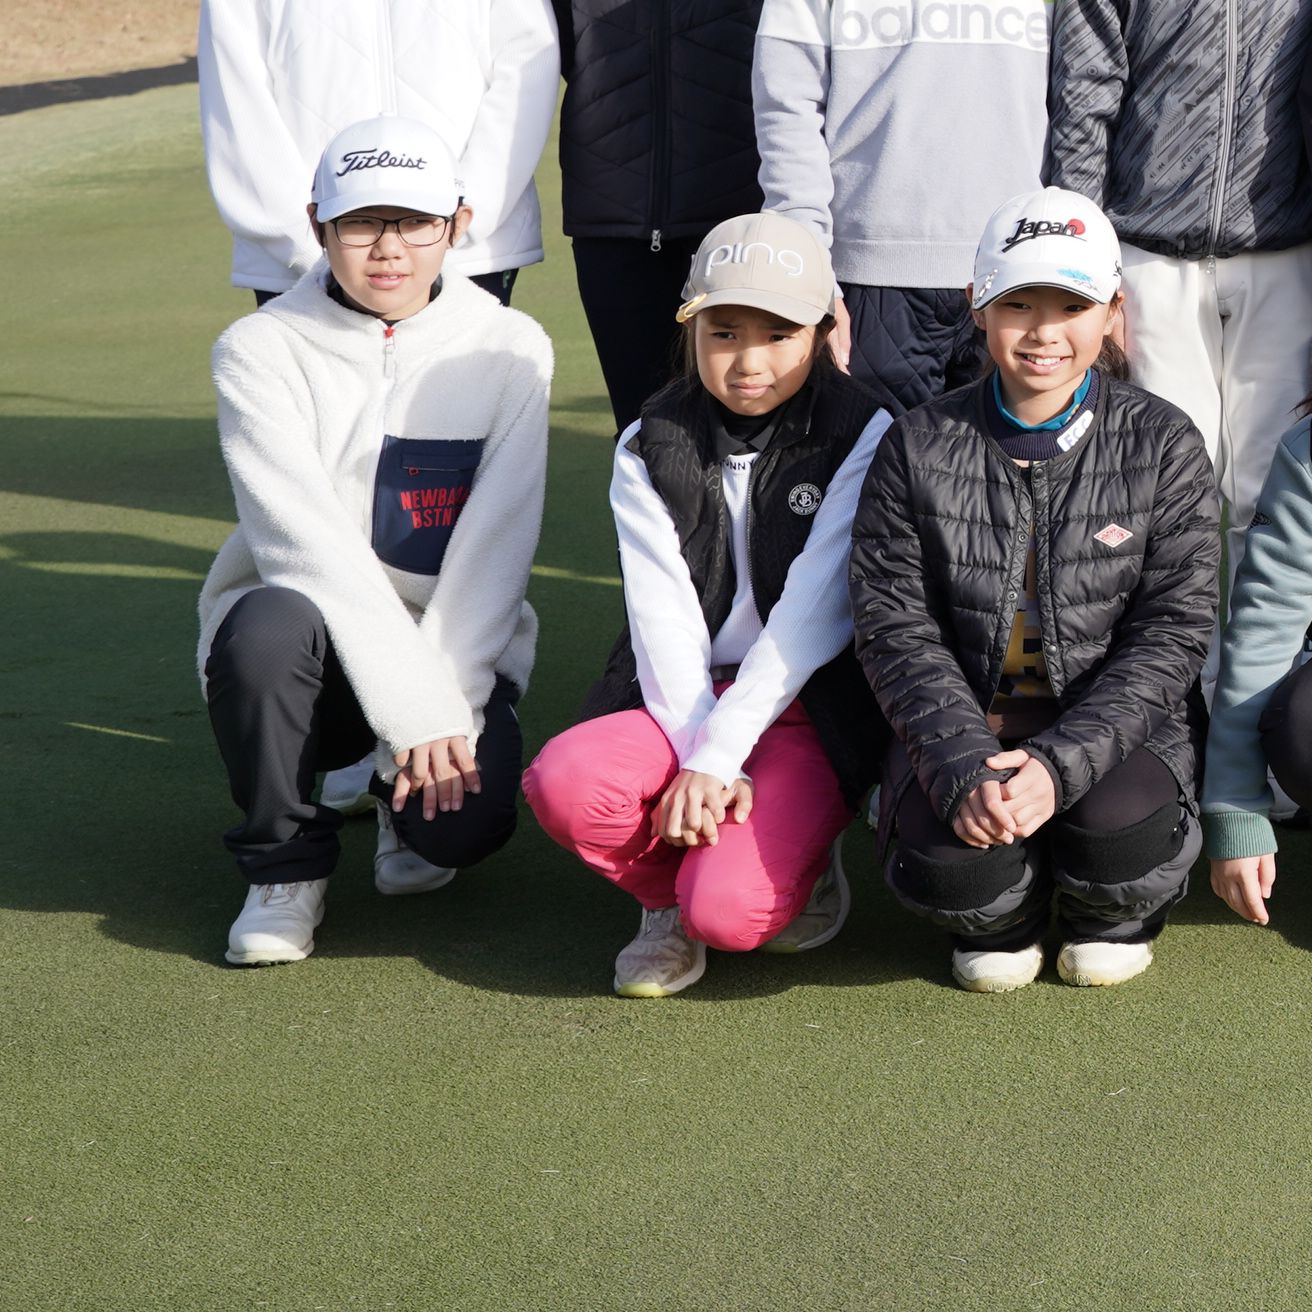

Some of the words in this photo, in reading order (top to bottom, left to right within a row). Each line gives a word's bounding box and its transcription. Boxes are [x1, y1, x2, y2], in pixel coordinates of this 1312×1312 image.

[336, 148, 428, 178] Titleist
[1003, 217, 1082, 246] Japan
[705, 241, 803, 280] ping
